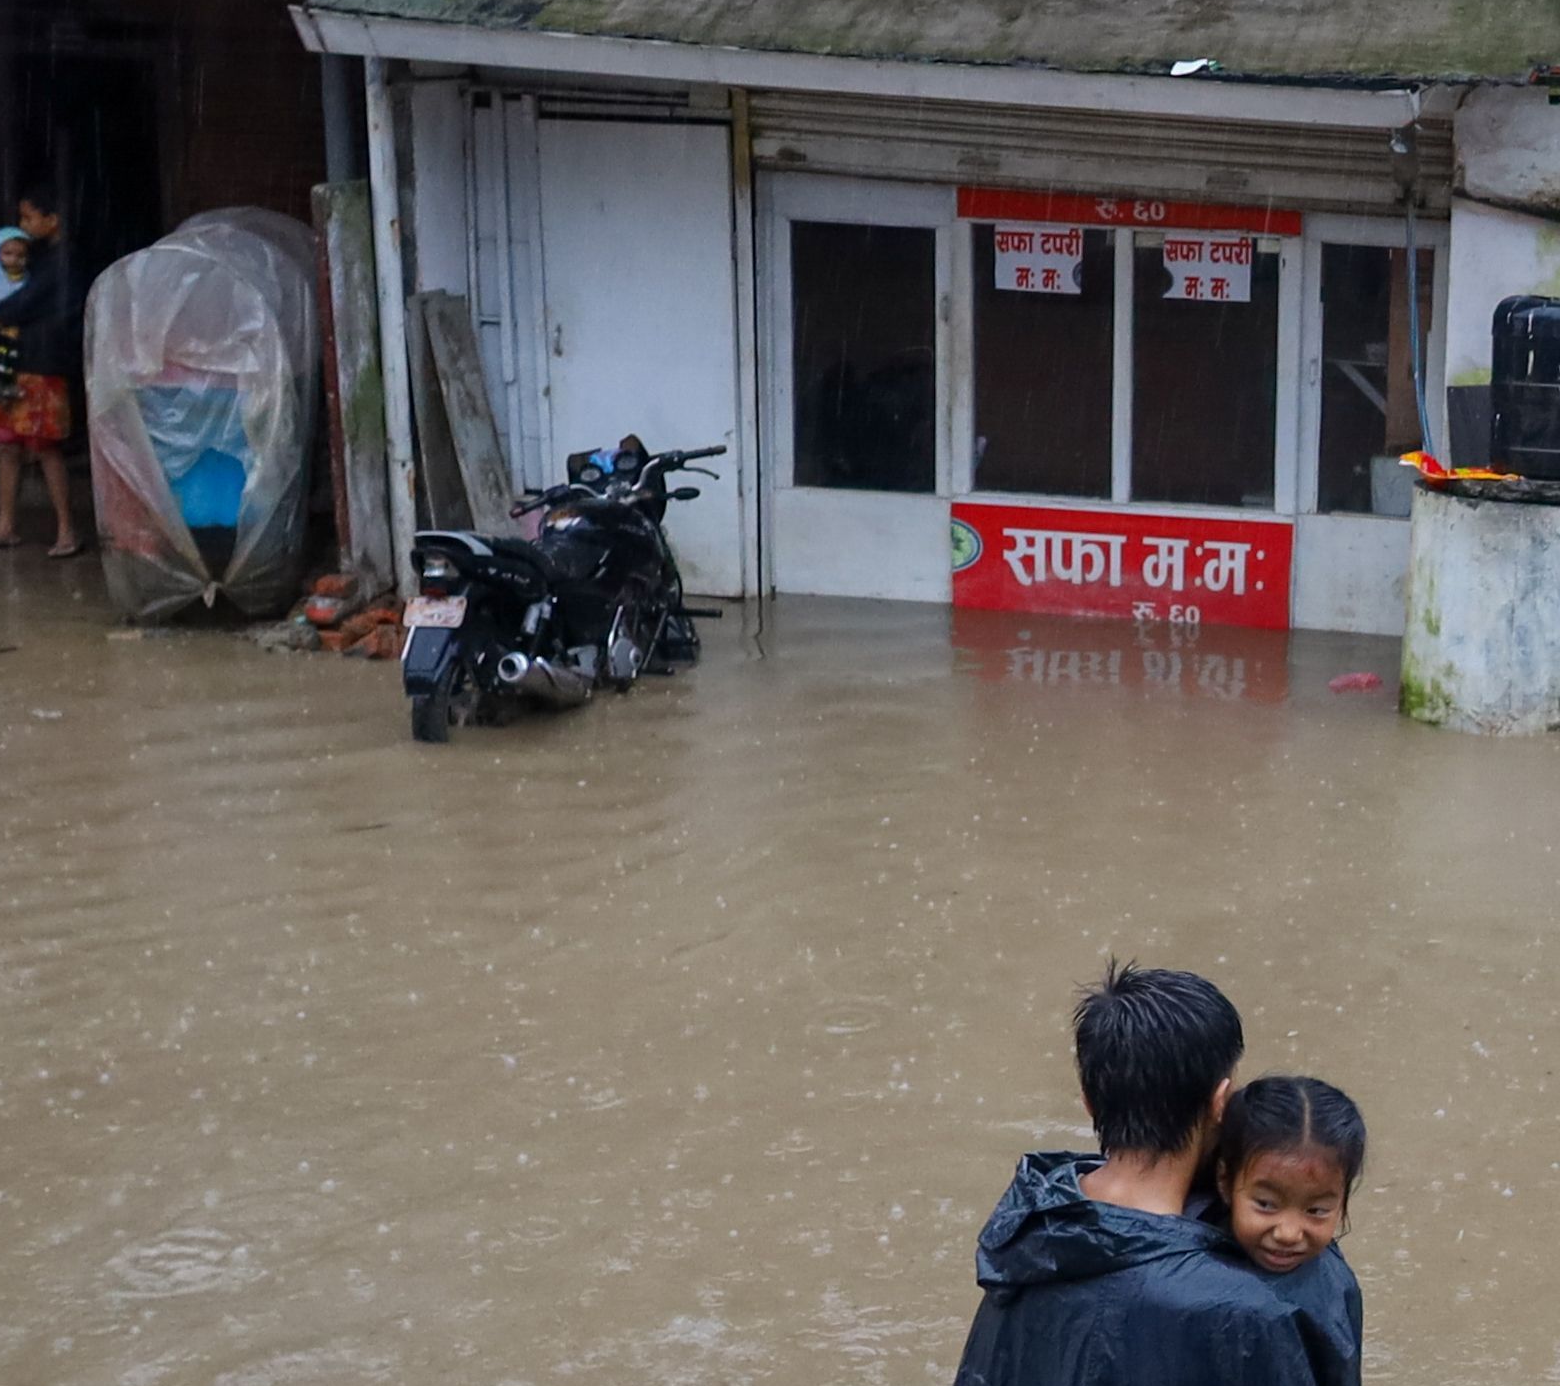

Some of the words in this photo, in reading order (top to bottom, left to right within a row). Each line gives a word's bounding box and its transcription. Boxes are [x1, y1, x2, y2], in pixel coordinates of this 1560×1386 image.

[1133, 200, 1166, 222] ६०
[995, 231, 1034, 254] सफा
[1040, 227, 1081, 257] टपरी
[1164, 239, 1204, 263] सफा
[1209, 236, 1252, 265] टपरी
[1002, 527, 1128, 587] सफा
[1168, 604, 1201, 623] ६०
